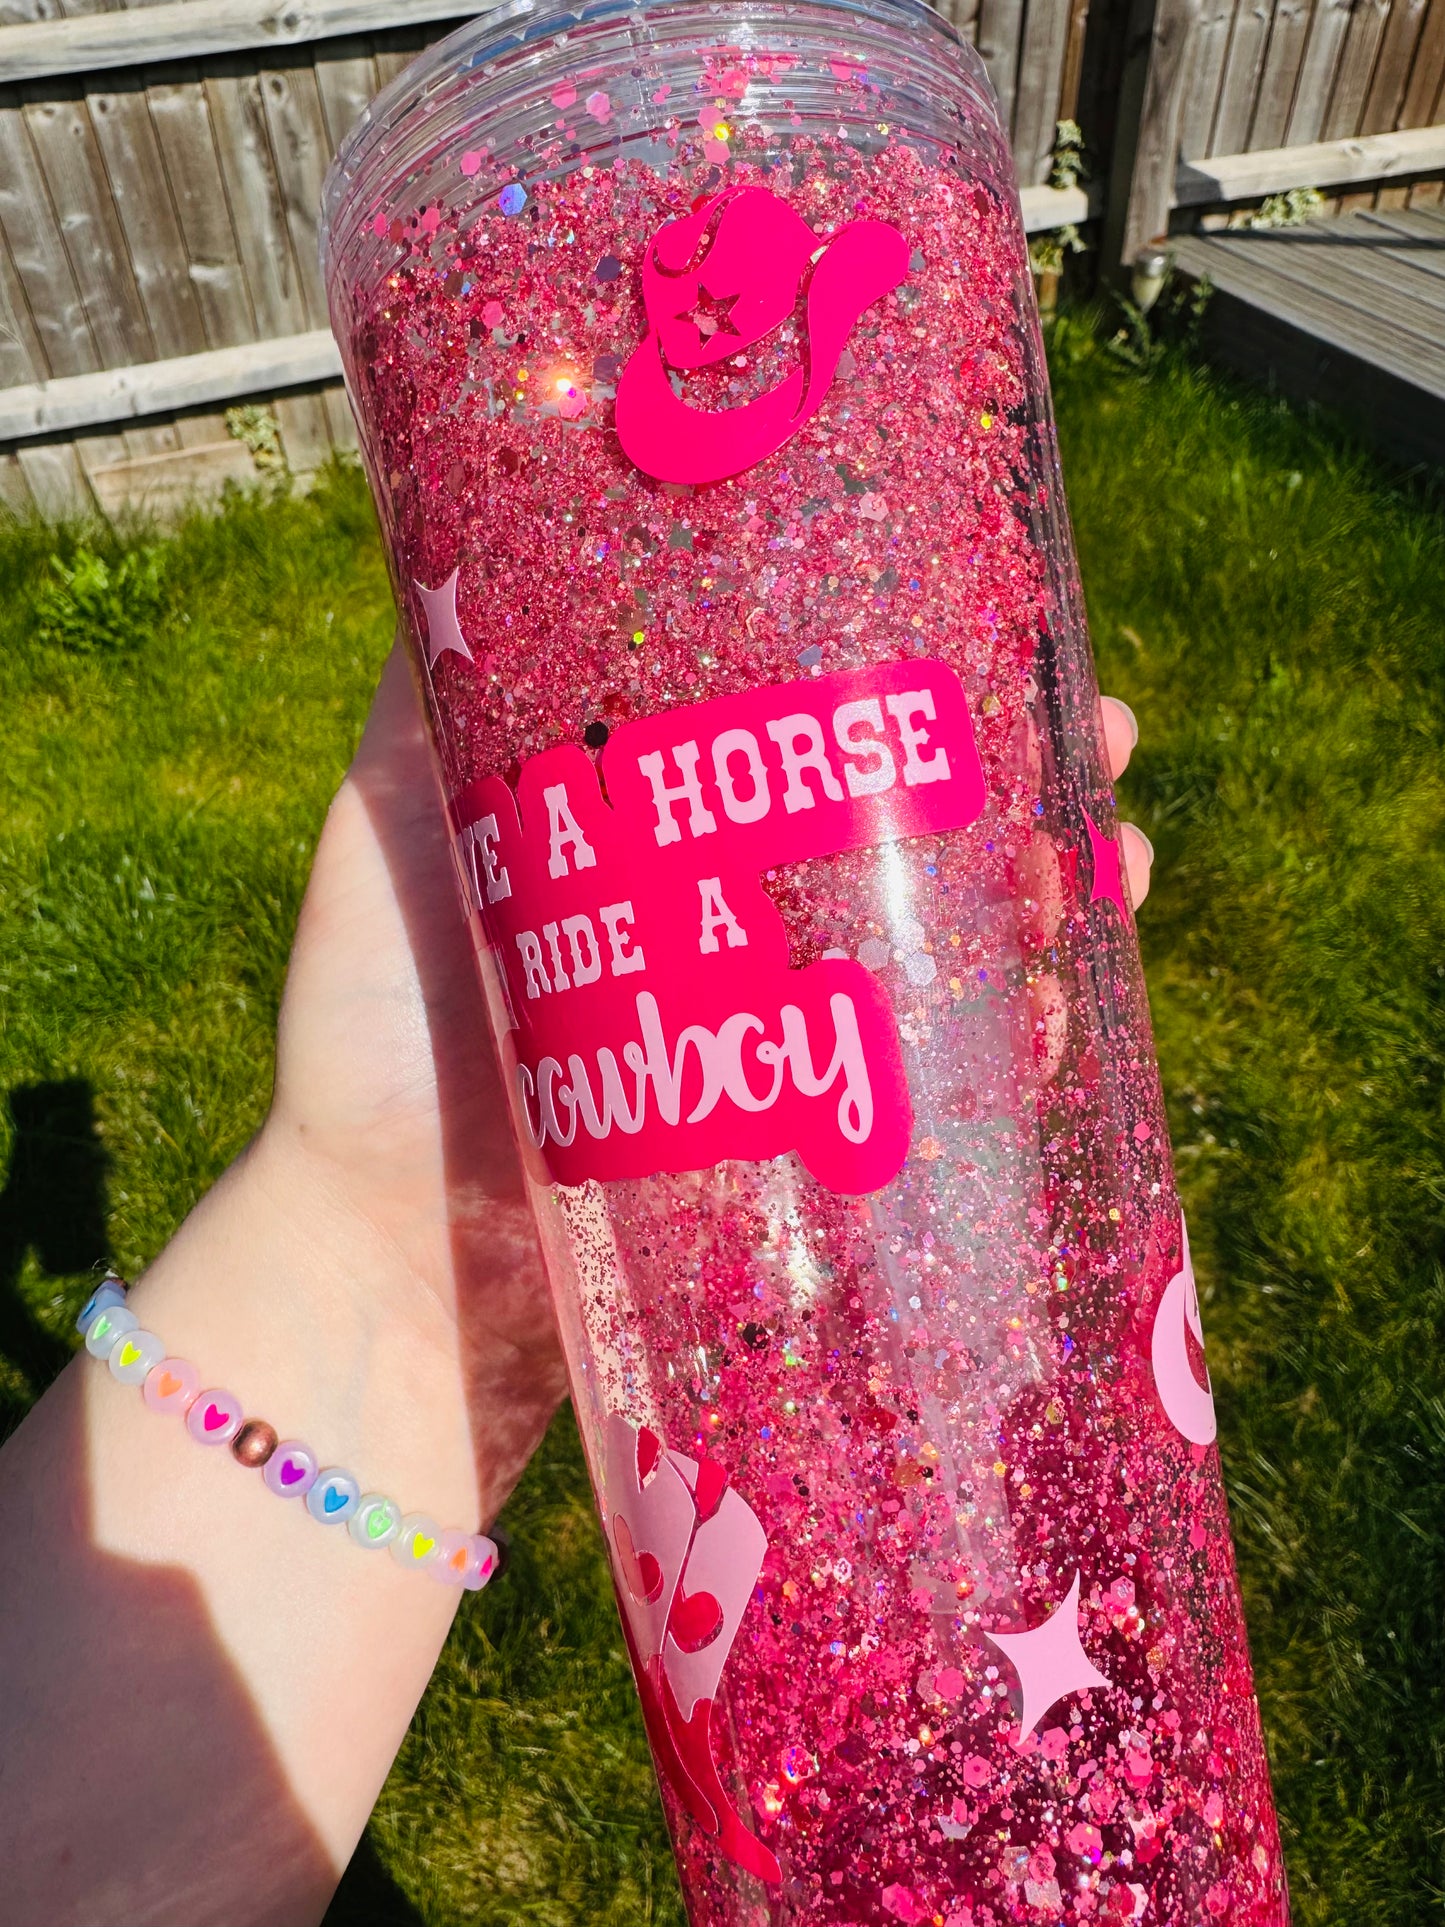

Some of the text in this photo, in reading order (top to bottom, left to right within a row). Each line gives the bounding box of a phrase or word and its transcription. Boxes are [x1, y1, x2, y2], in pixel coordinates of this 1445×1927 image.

[450, 689, 951, 917] VE A HORSE
[515, 901, 646, 999] RIDE
[698, 877, 748, 954] A
